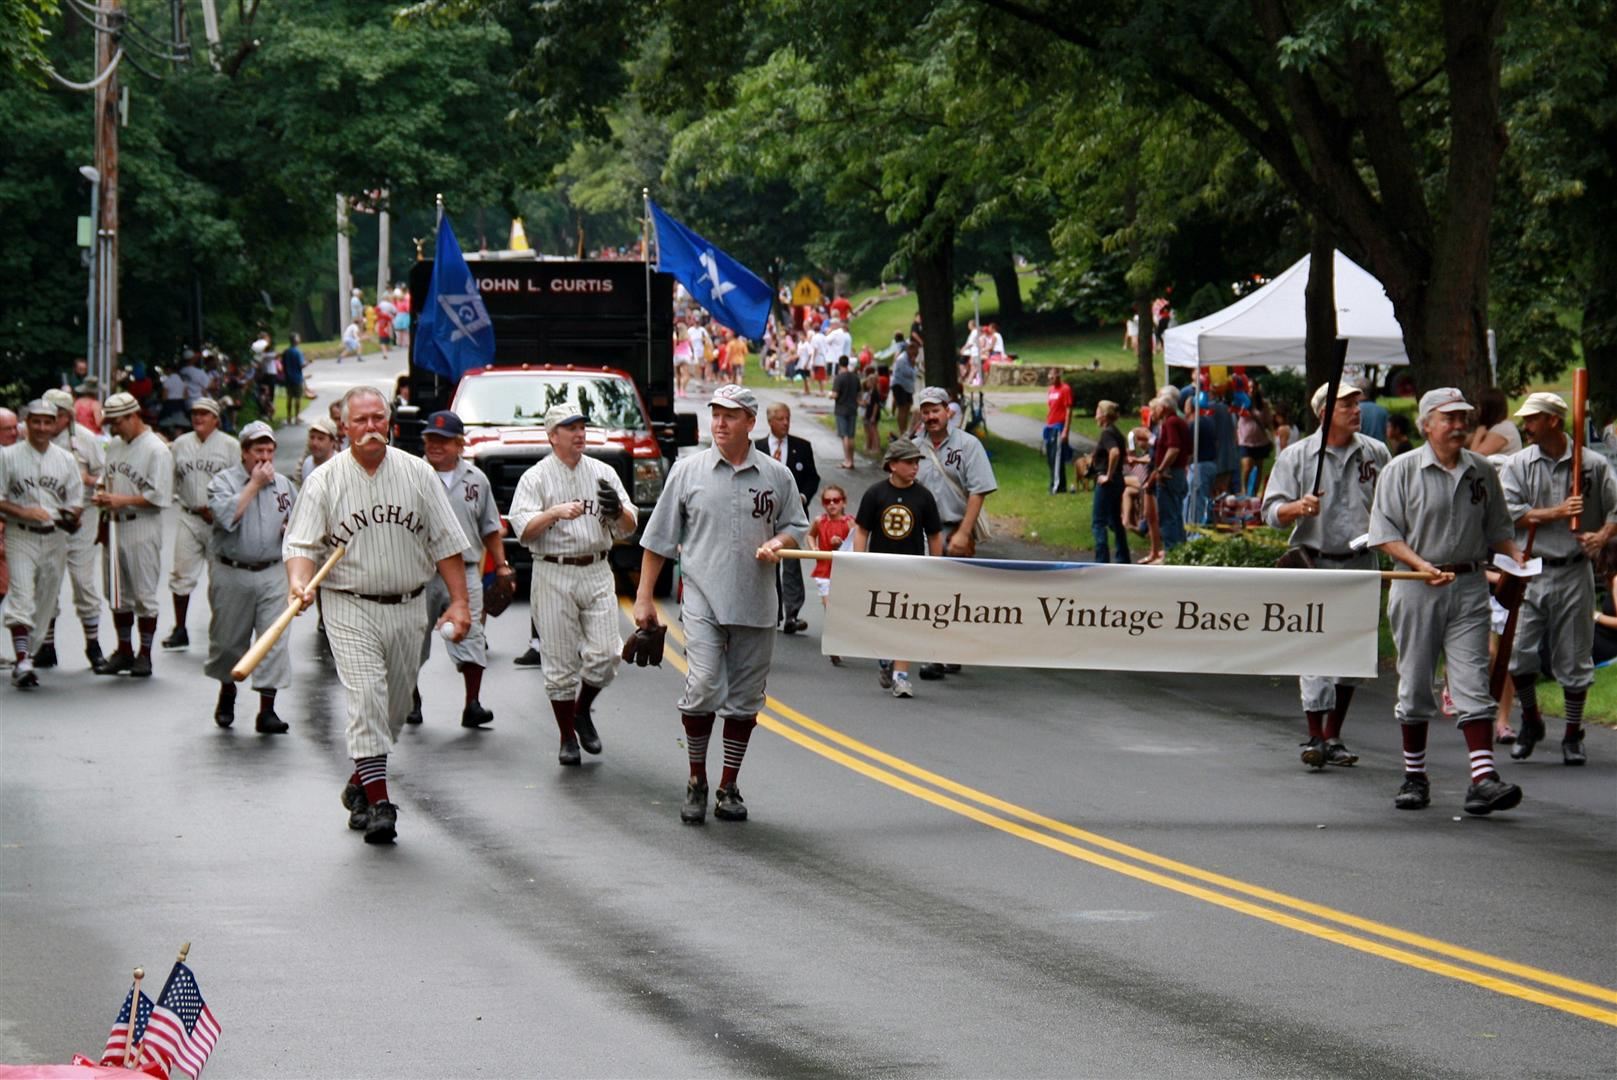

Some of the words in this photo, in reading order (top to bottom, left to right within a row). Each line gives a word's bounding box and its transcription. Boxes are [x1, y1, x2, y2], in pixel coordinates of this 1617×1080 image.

[476, 278, 519, 292] JOHN
[550, 279, 613, 292] CURTIS
[867, 590, 1023, 630] Hingham
[1037, 597, 1165, 637] Vintage
[1176, 601, 1250, 633] Base
[1261, 603, 1325, 634] Ball
